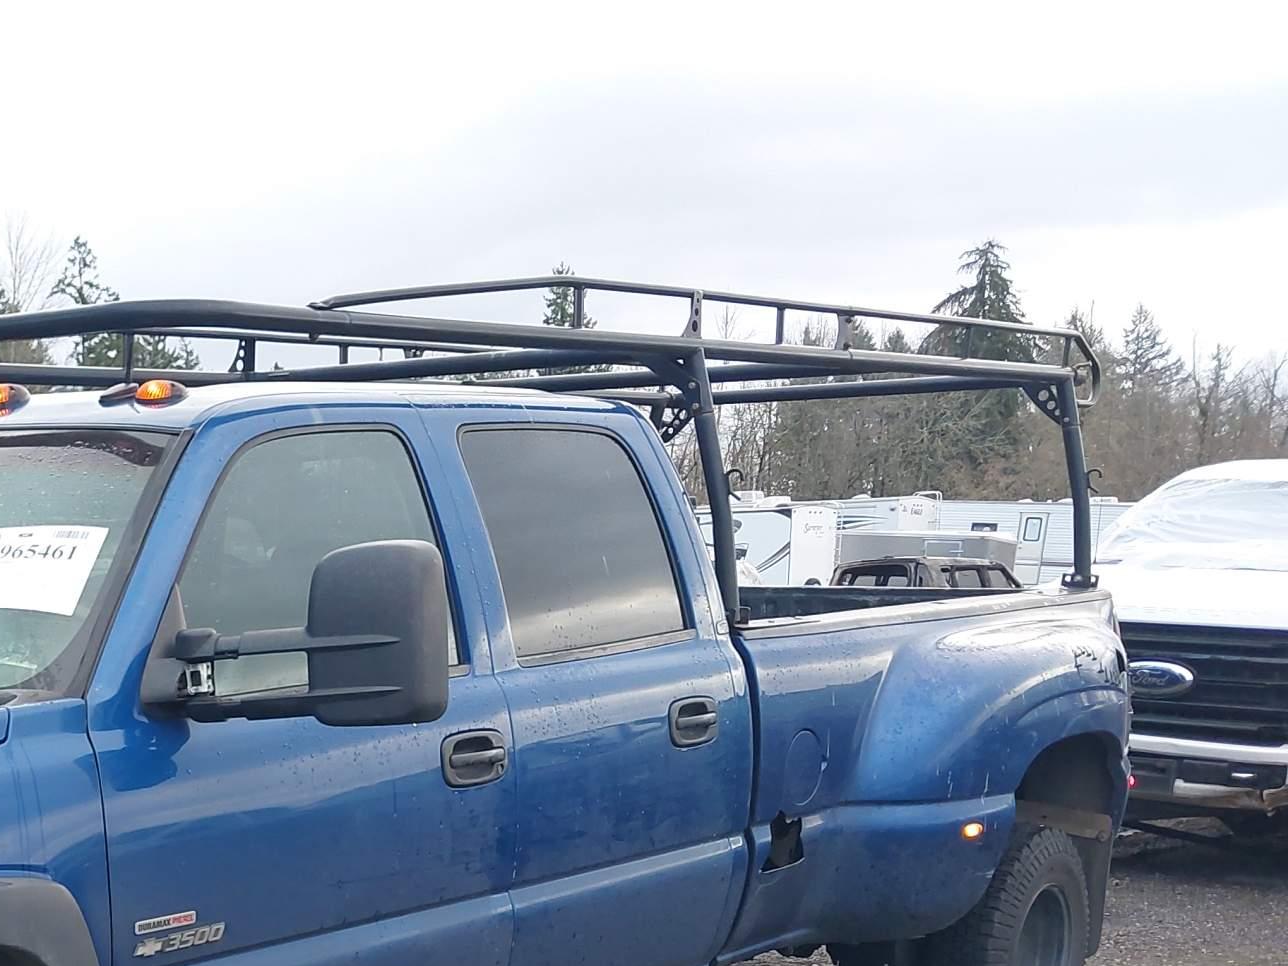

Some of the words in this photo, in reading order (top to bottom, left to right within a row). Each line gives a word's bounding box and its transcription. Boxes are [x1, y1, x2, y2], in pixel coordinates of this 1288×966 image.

[1132, 669, 1170, 686] Ford
[137, 918, 171, 932] DURAMAX
[164, 922, 226, 952] 3500
